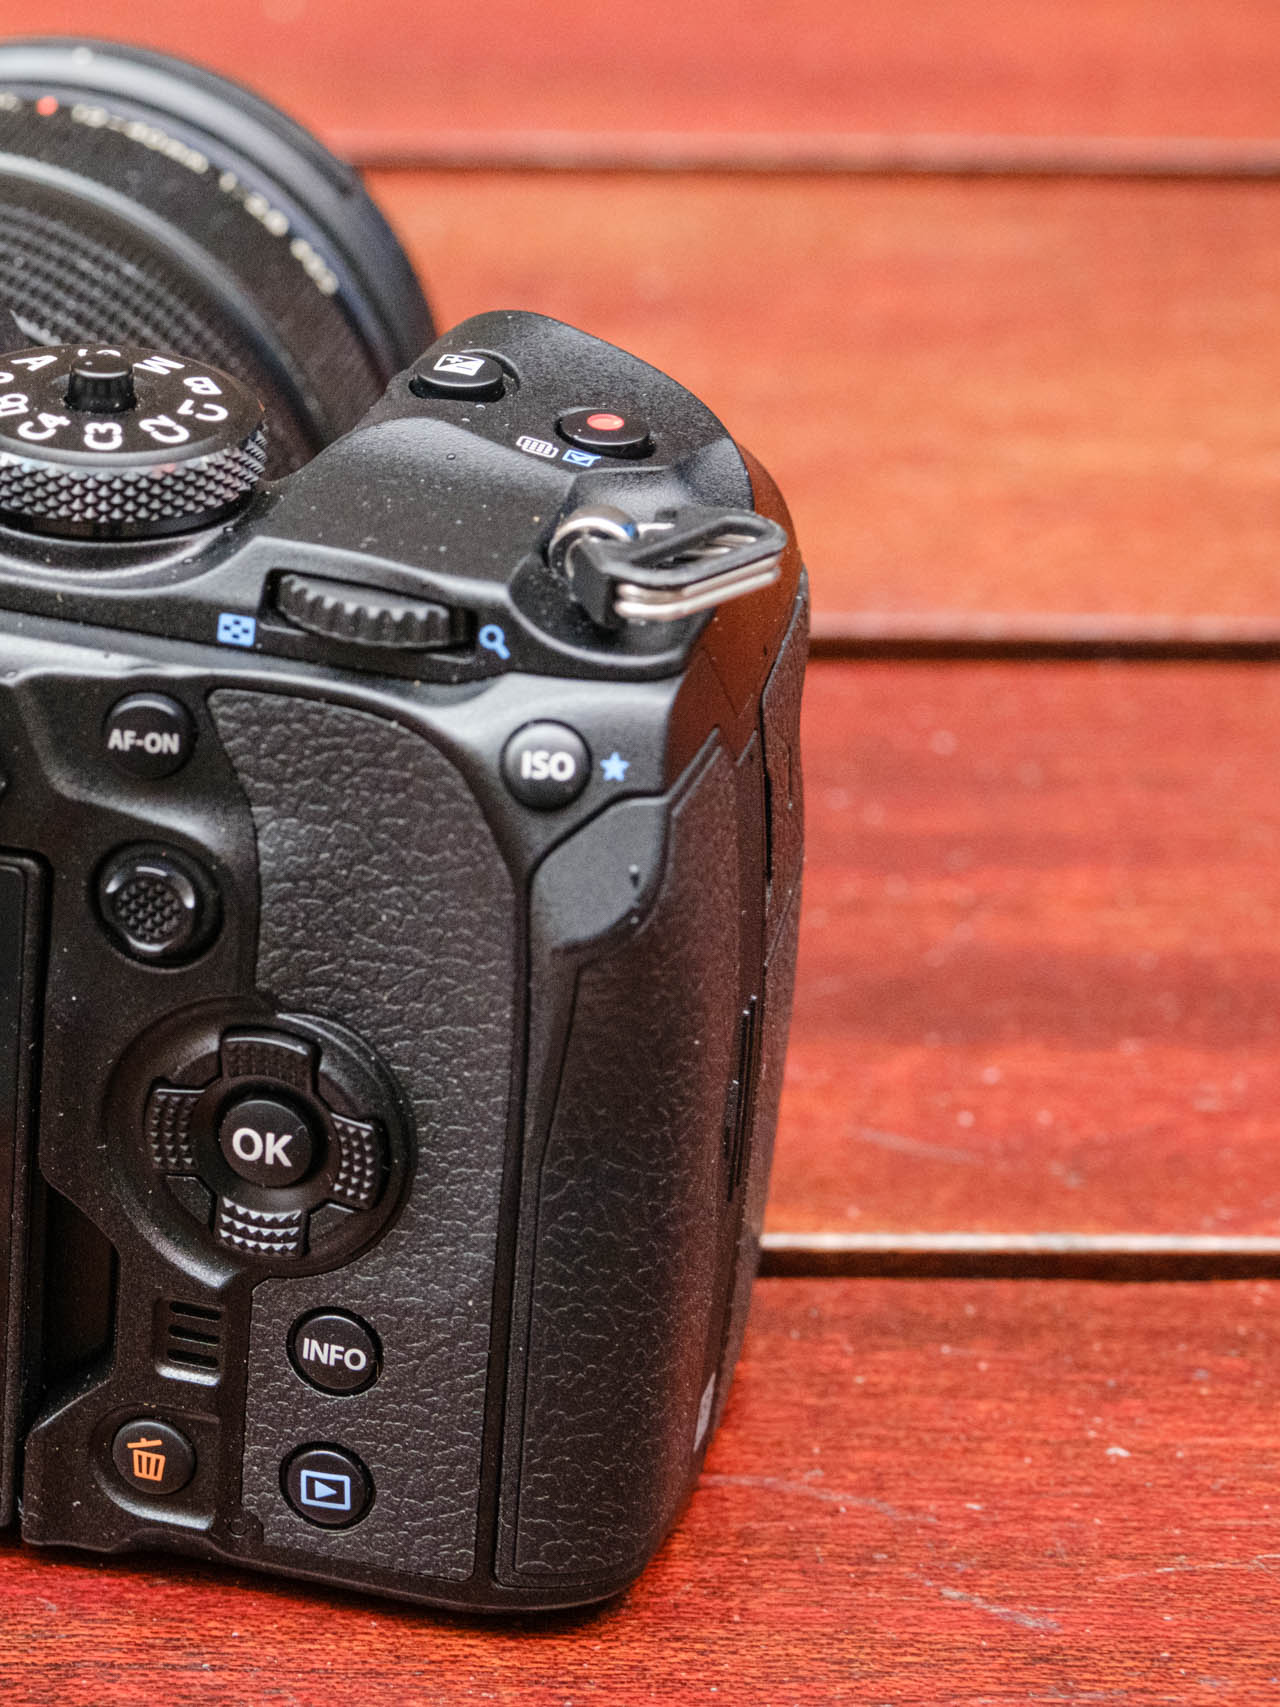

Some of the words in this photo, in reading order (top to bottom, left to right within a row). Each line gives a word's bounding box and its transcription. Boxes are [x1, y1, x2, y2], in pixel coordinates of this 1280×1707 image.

[12, 354, 58, 371] A
[183, 376, 222, 395] B
[17, 412, 71, 441] C4
[83, 422, 123, 450] C3
[138, 414, 190, 444] C2
[107, 728, 180, 755] AF-ON
[520, 750, 576, 782] ISO
[231, 1127, 293, 1167] OK
[302, 1337, 367, 1372] INFO
